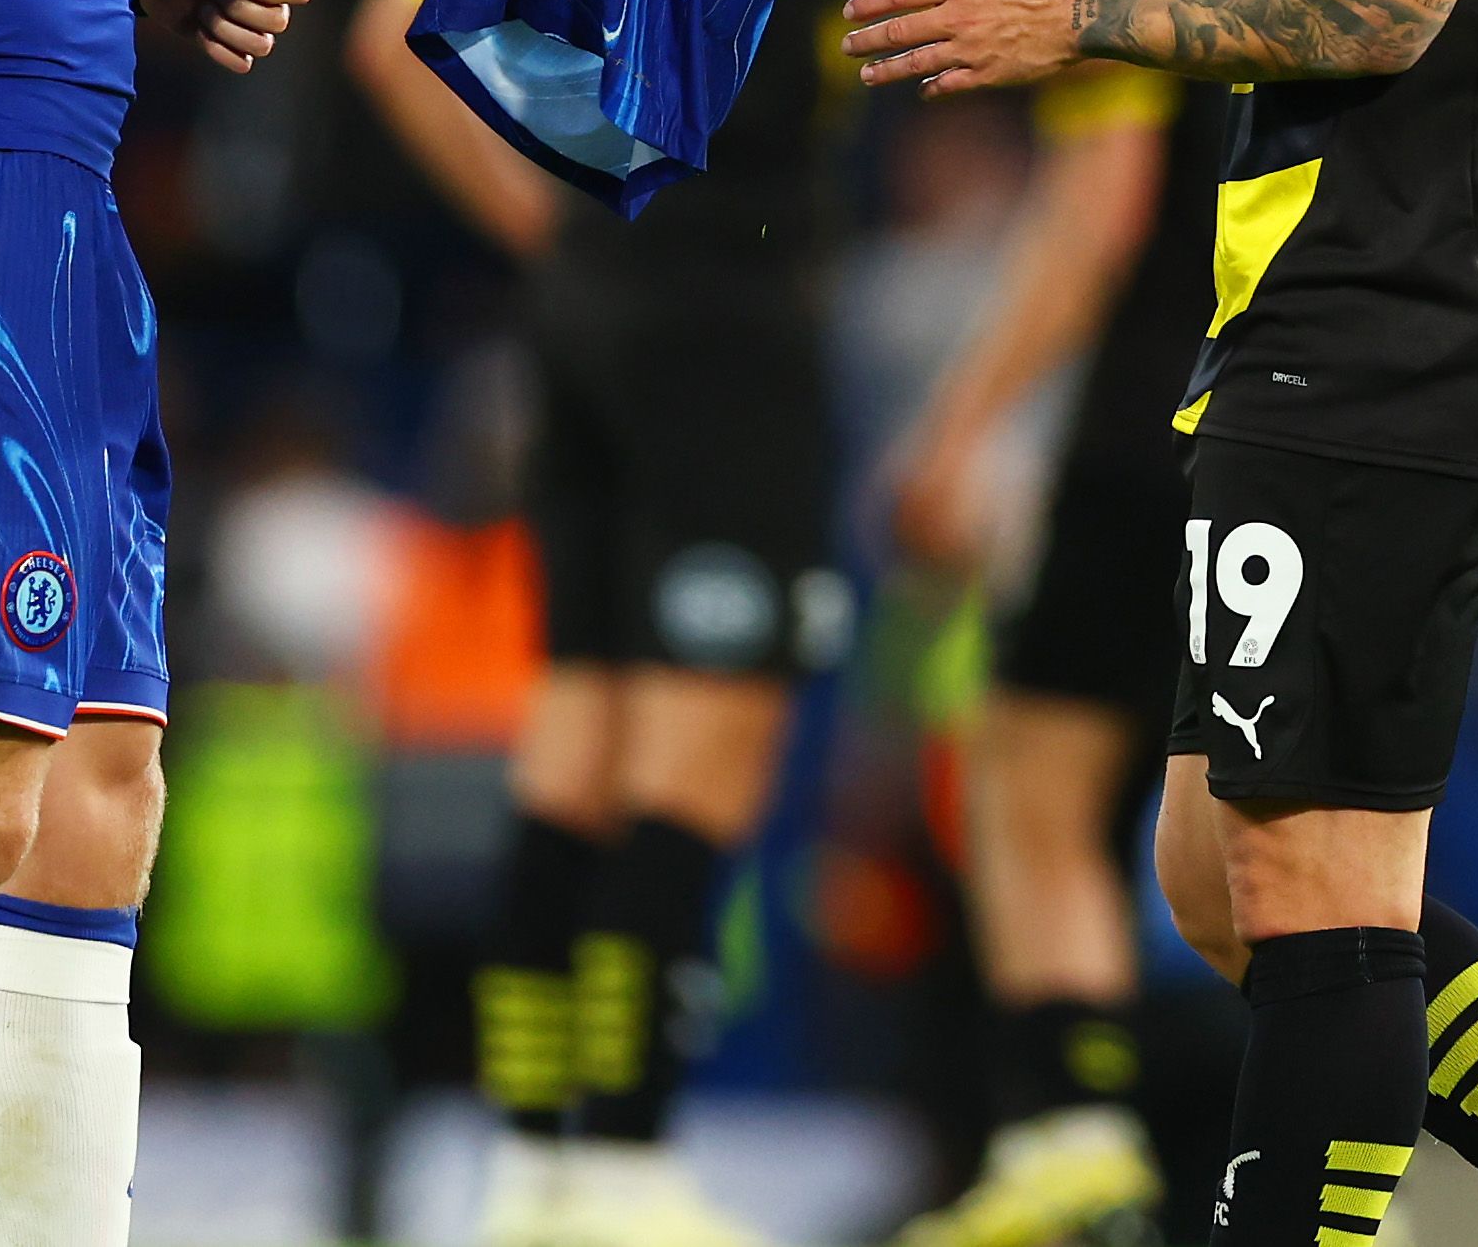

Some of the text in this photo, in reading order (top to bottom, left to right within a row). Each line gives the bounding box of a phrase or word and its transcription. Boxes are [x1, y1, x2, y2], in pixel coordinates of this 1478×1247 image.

[1272, 371, 1308, 387] DRYCELL
[19, 555, 66, 582] CHELSEA
[1185, 519, 1304, 667] 19
[1244, 656, 1258, 665] EFL
